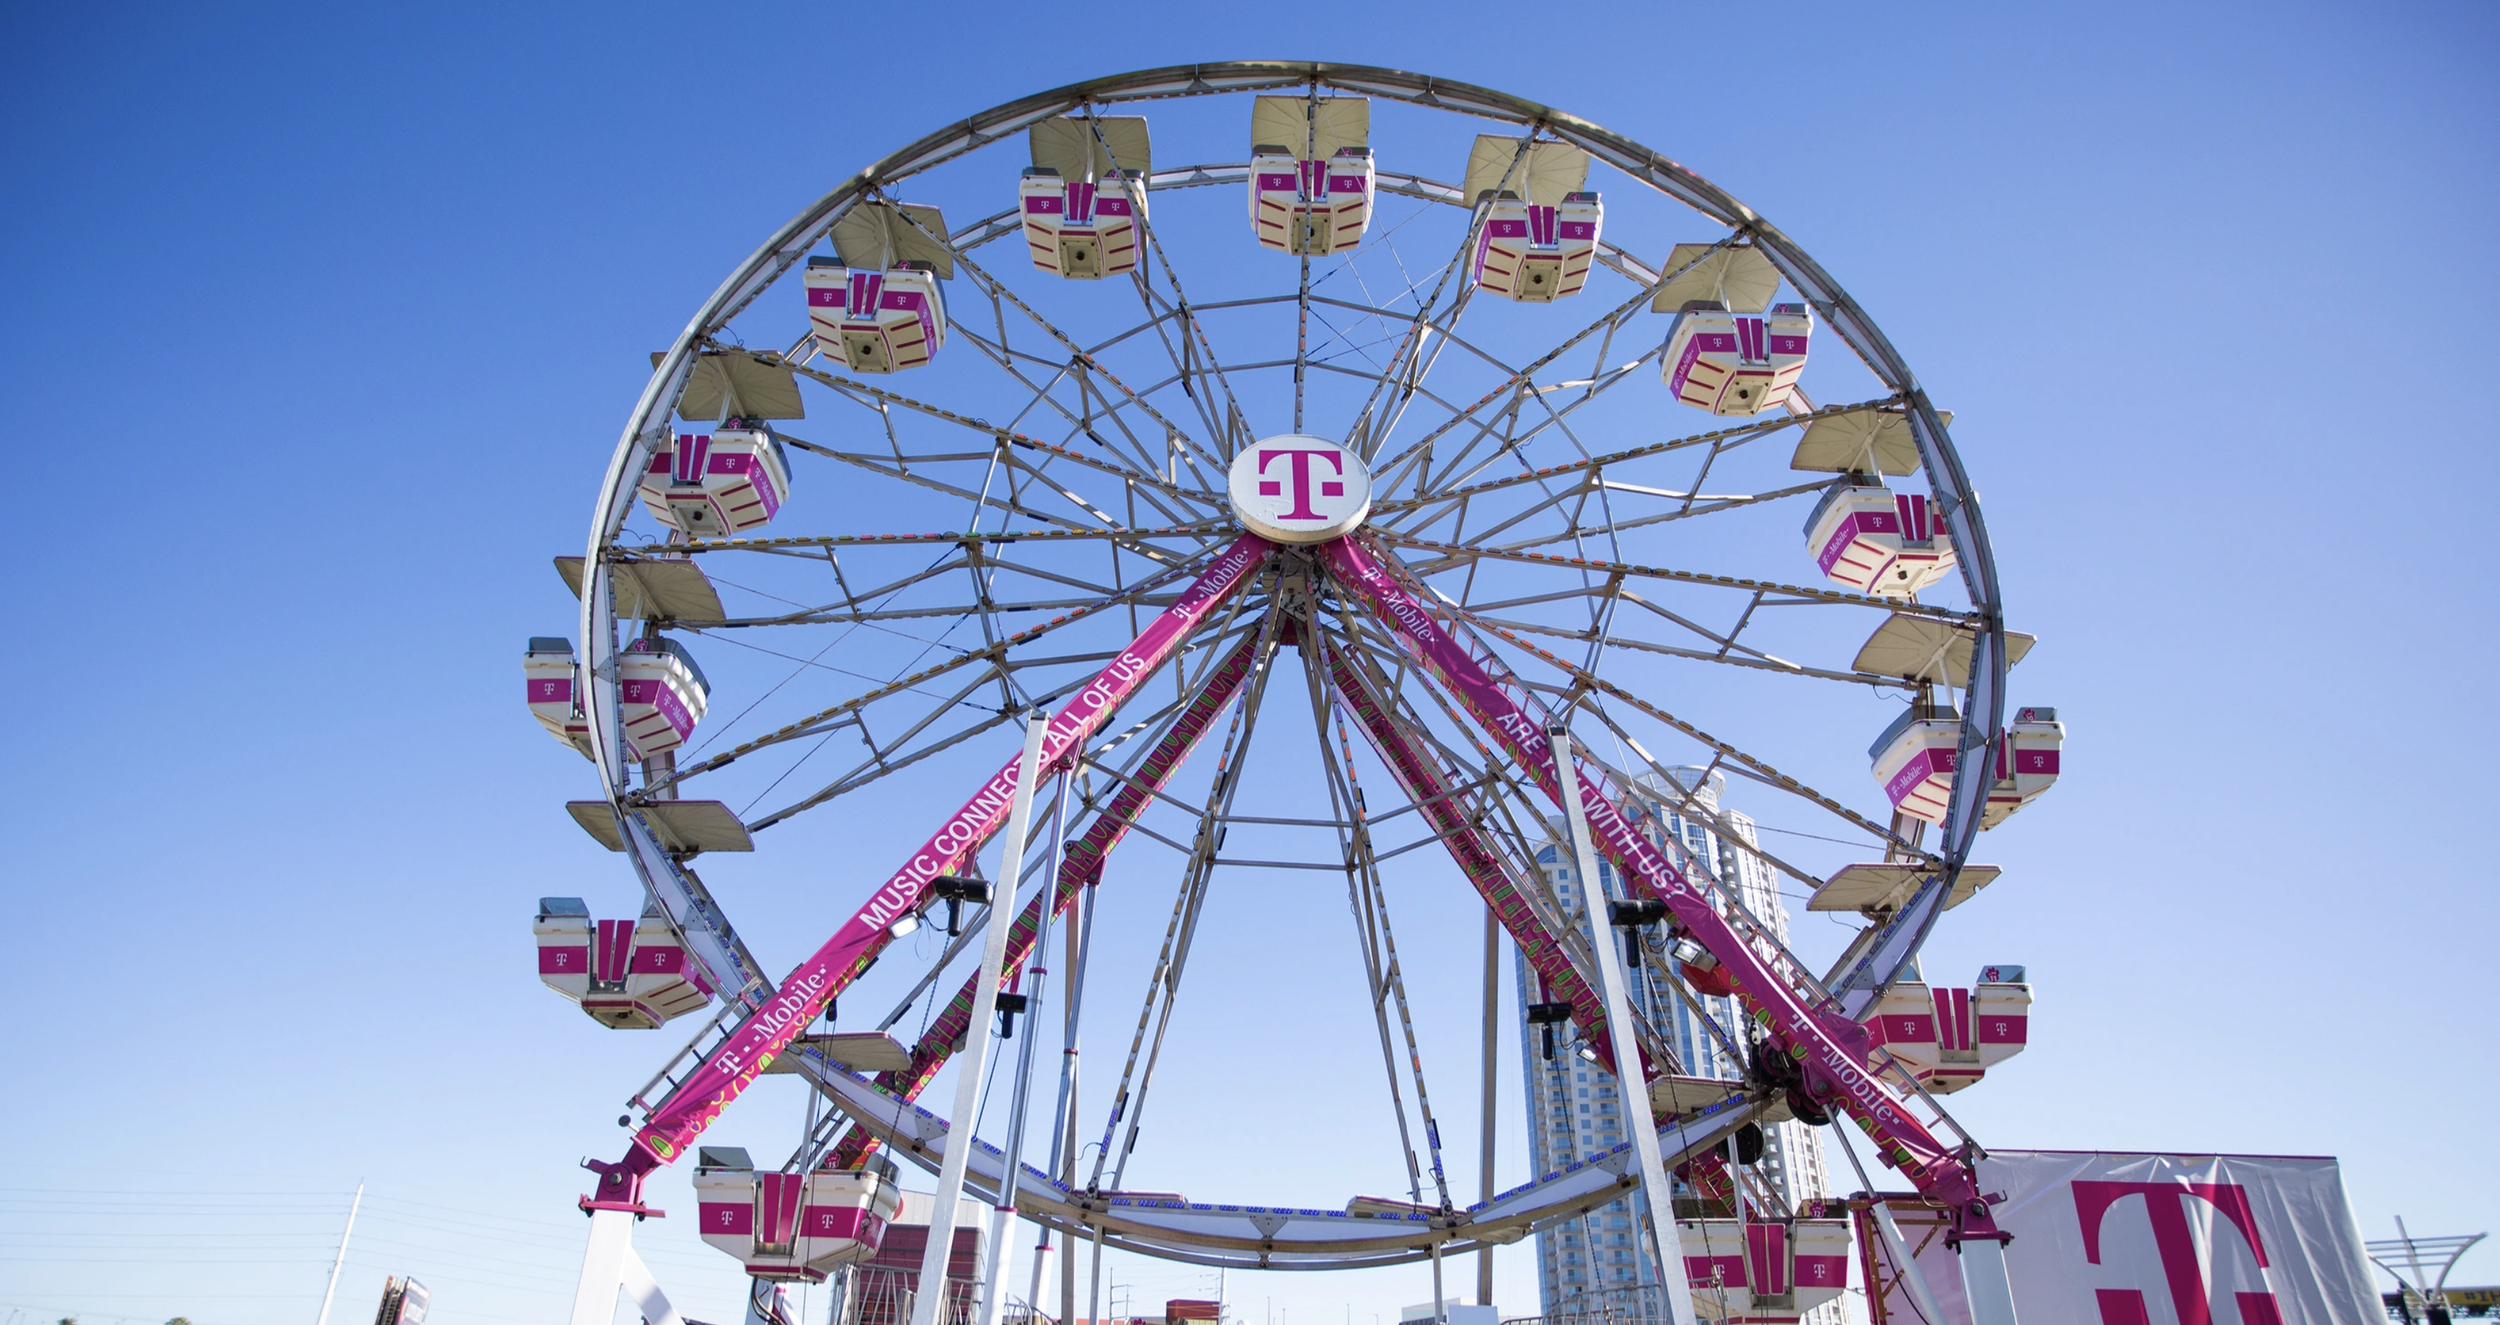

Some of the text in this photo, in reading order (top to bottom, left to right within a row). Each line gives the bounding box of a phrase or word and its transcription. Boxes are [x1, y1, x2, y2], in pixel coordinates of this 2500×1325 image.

[1258, 449, 1344, 520] T
[859, 854, 938, 931] MUSIC
[1047, 711, 1090, 749] ALL
[1082, 677, 1114, 709] OF
[1109, 652, 1145, 681] US
[1496, 712, 1687, 900] ARE WITH US?
